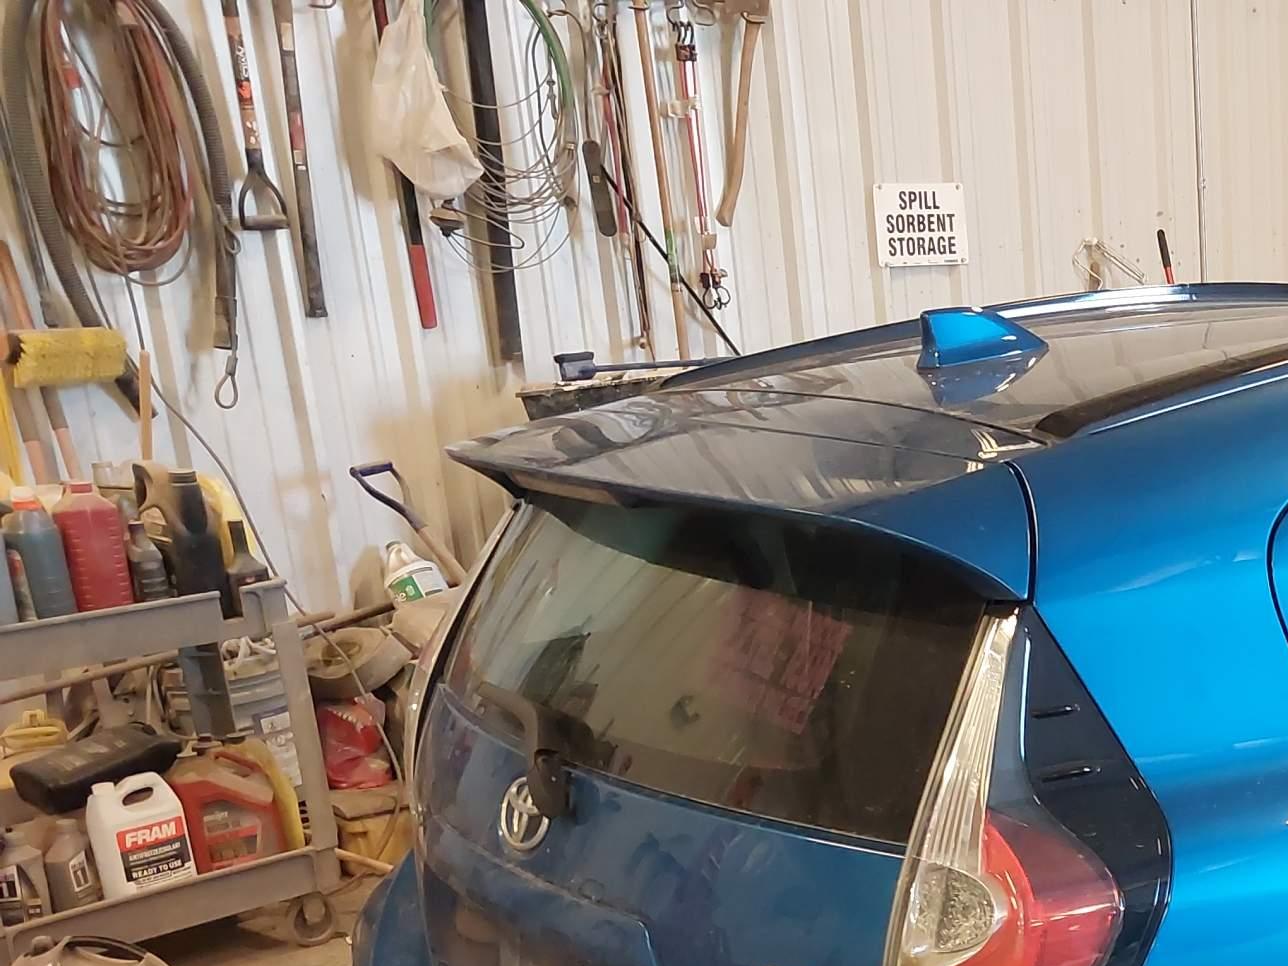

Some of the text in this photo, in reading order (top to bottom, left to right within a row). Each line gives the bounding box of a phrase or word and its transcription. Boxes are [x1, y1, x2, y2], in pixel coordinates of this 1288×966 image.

[898, 190, 941, 210] SPILL
[886, 213, 956, 233] SORBENT
[888, 236, 957, 256] STORAGE
[125, 821, 177, 849] FRAM
[131, 867, 158, 879] READY
[159, 863, 169, 872] TO
[169, 859, 183, 869] USE
